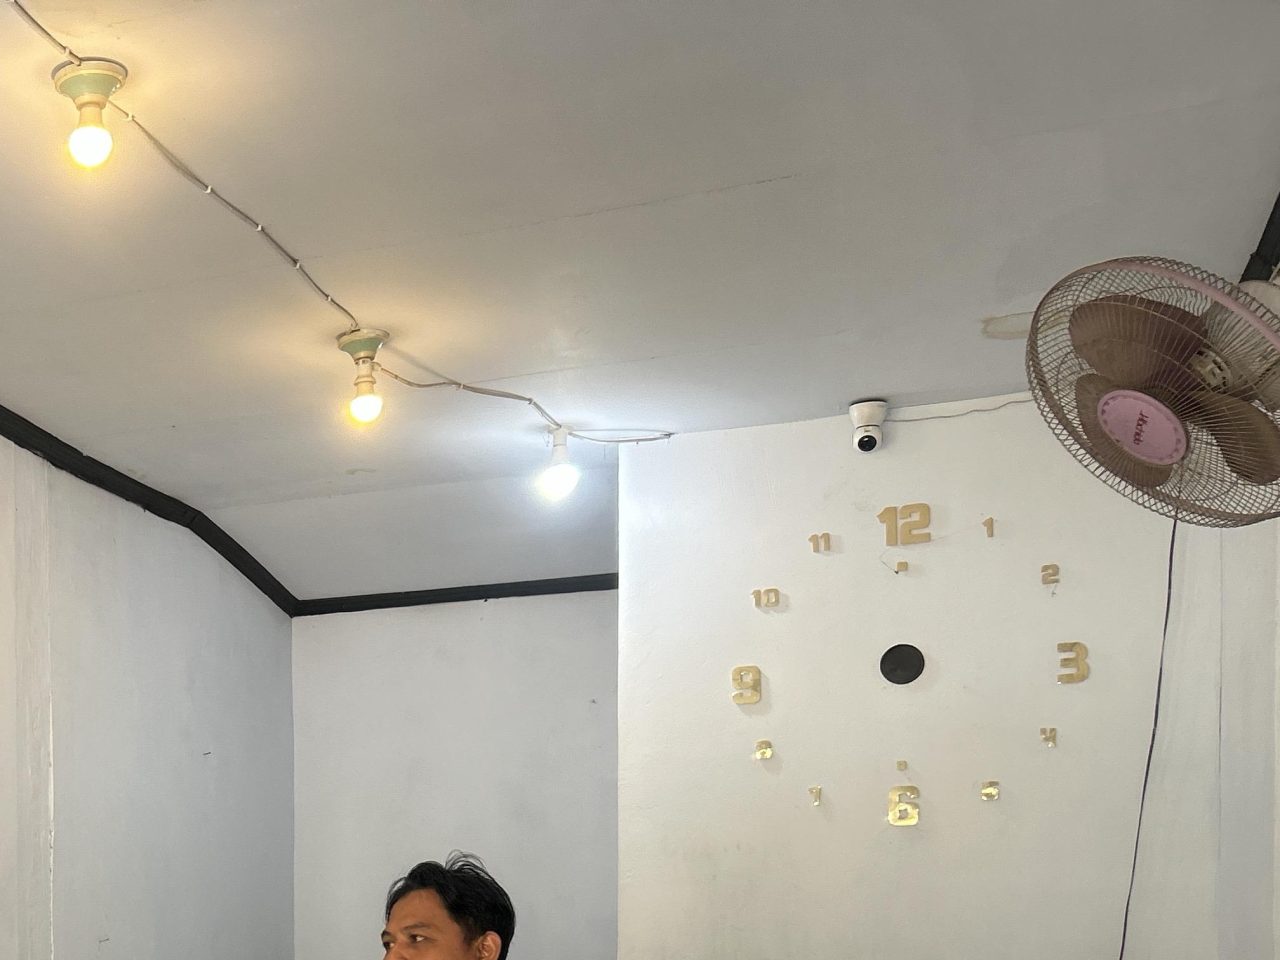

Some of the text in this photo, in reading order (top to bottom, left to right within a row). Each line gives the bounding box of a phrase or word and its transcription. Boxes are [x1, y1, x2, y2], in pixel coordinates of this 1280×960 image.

[876, 502, 932, 547] 12
[981, 516, 996, 538] 1
[808, 531, 831, 553] 11
[1040, 563, 1061, 585] 2
[751, 587, 780, 608] 10
[1056, 641, 1091, 684] 3
[731, 665, 762, 705] 9
[1039, 727, 1058, 748] 4
[754, 739, 774, 760] 8
[807, 784, 823, 806] 7
[887, 785, 920, 827] 6
